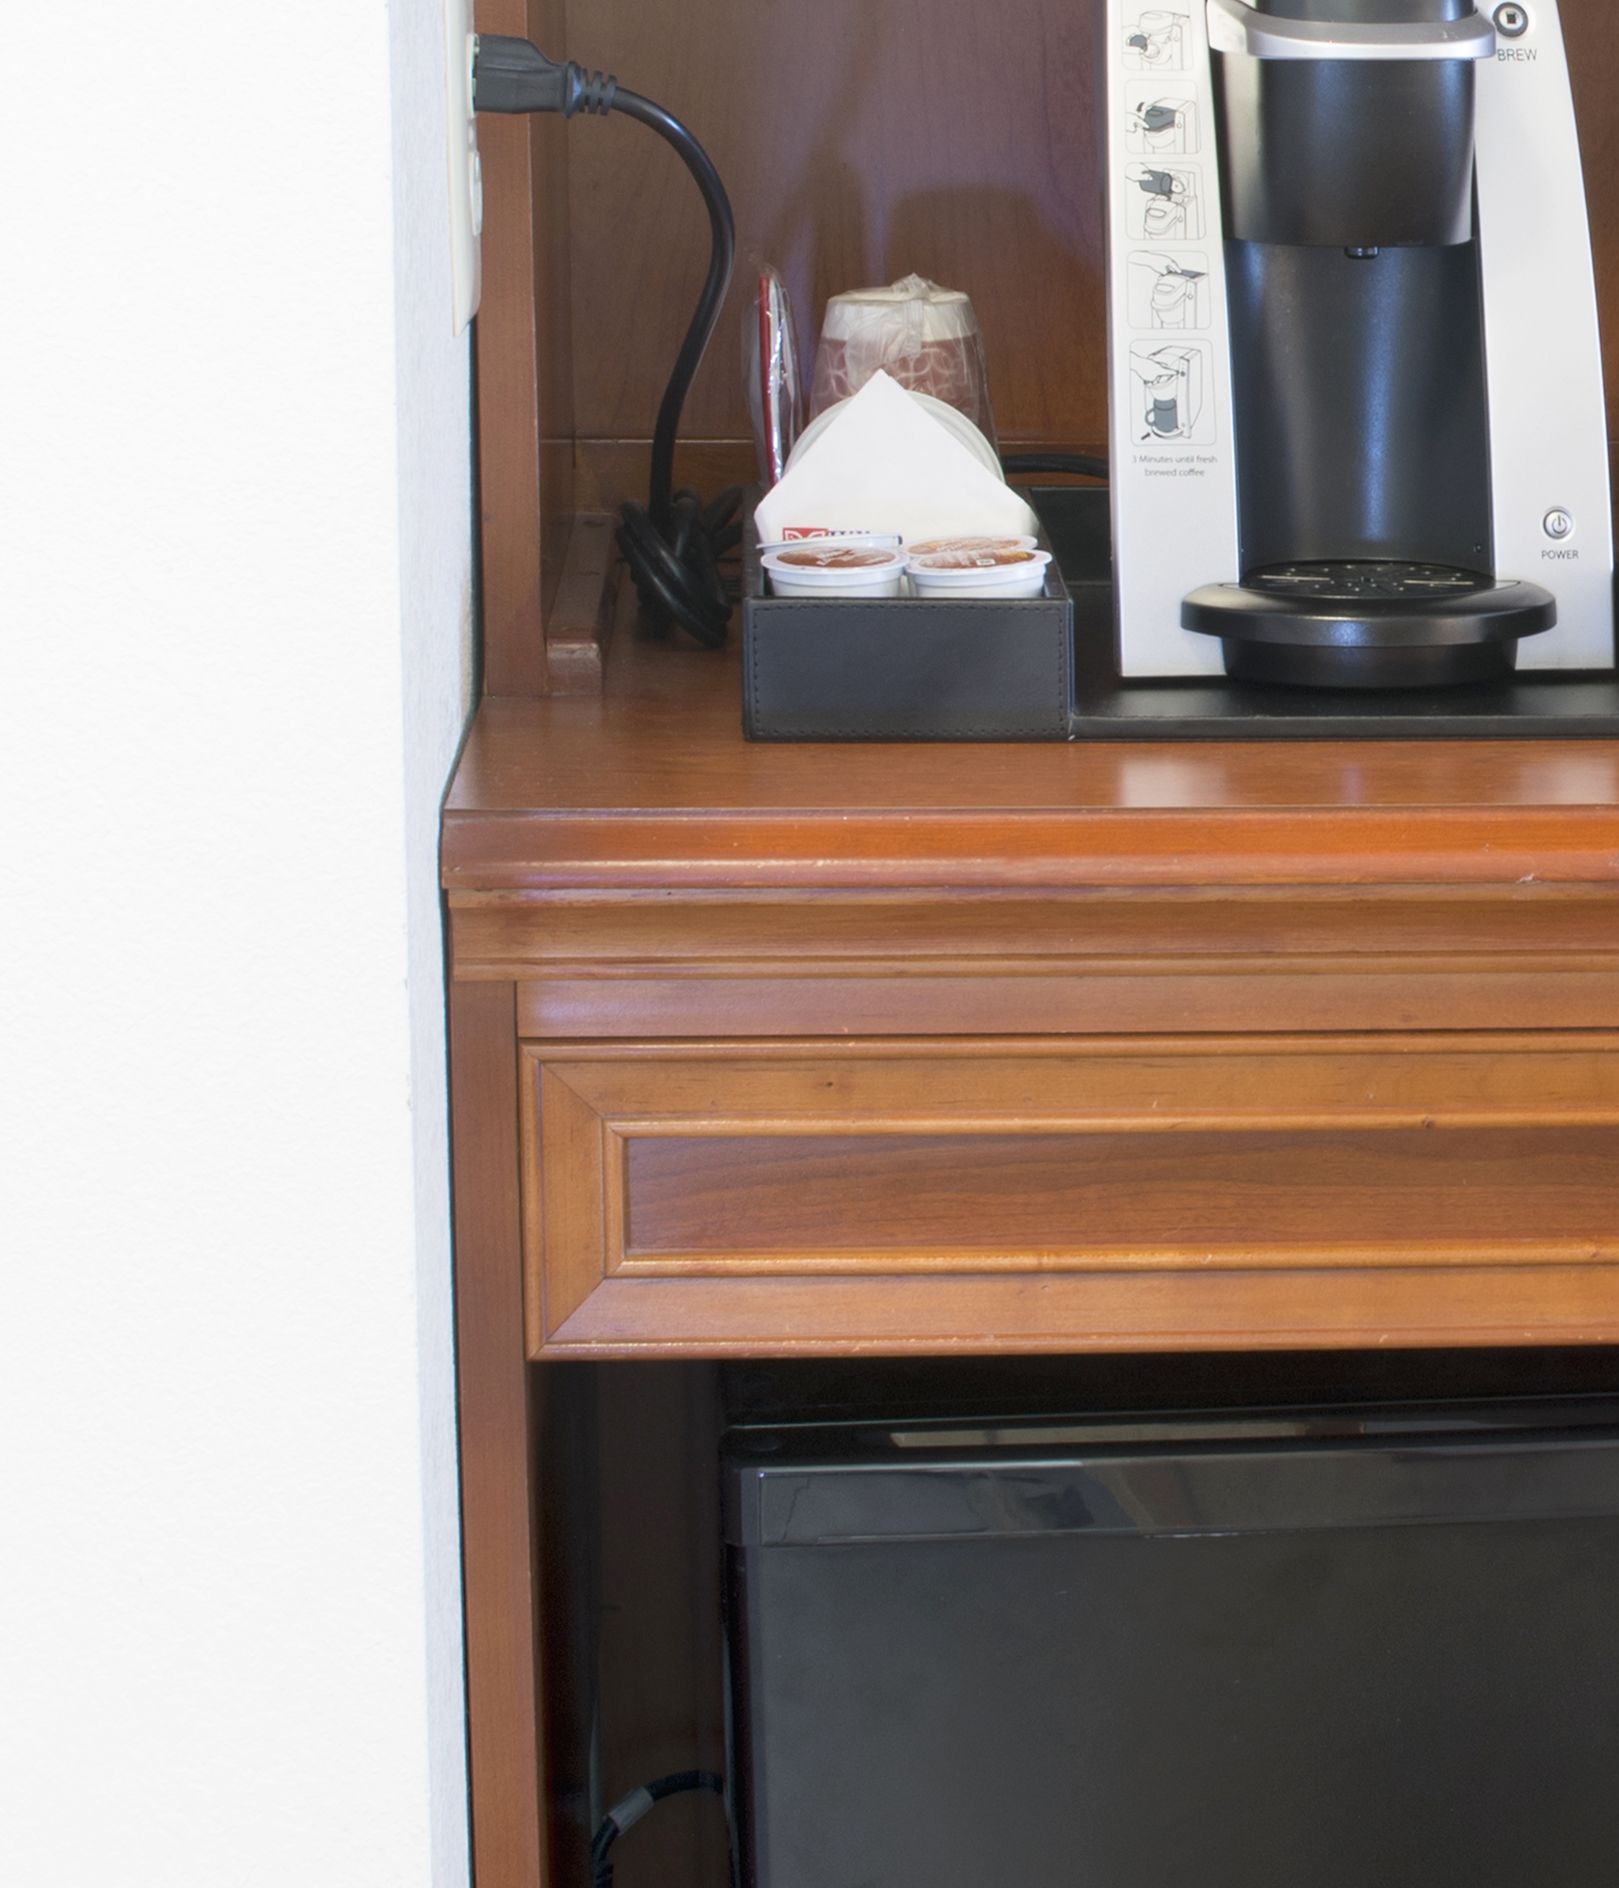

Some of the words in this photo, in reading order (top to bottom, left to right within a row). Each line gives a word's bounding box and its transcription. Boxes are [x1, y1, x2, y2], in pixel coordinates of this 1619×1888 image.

[1497, 48, 1537, 62] BREW
[1139, 455, 1173, 464] Minutes
[1175, 455, 1195, 464] until
[1196, 455, 1218, 464] fresh
[1144, 468, 1177, 477] brewed
[1178, 468, 1205, 477] coffee
[1541, 549, 1579, 560] POWER
